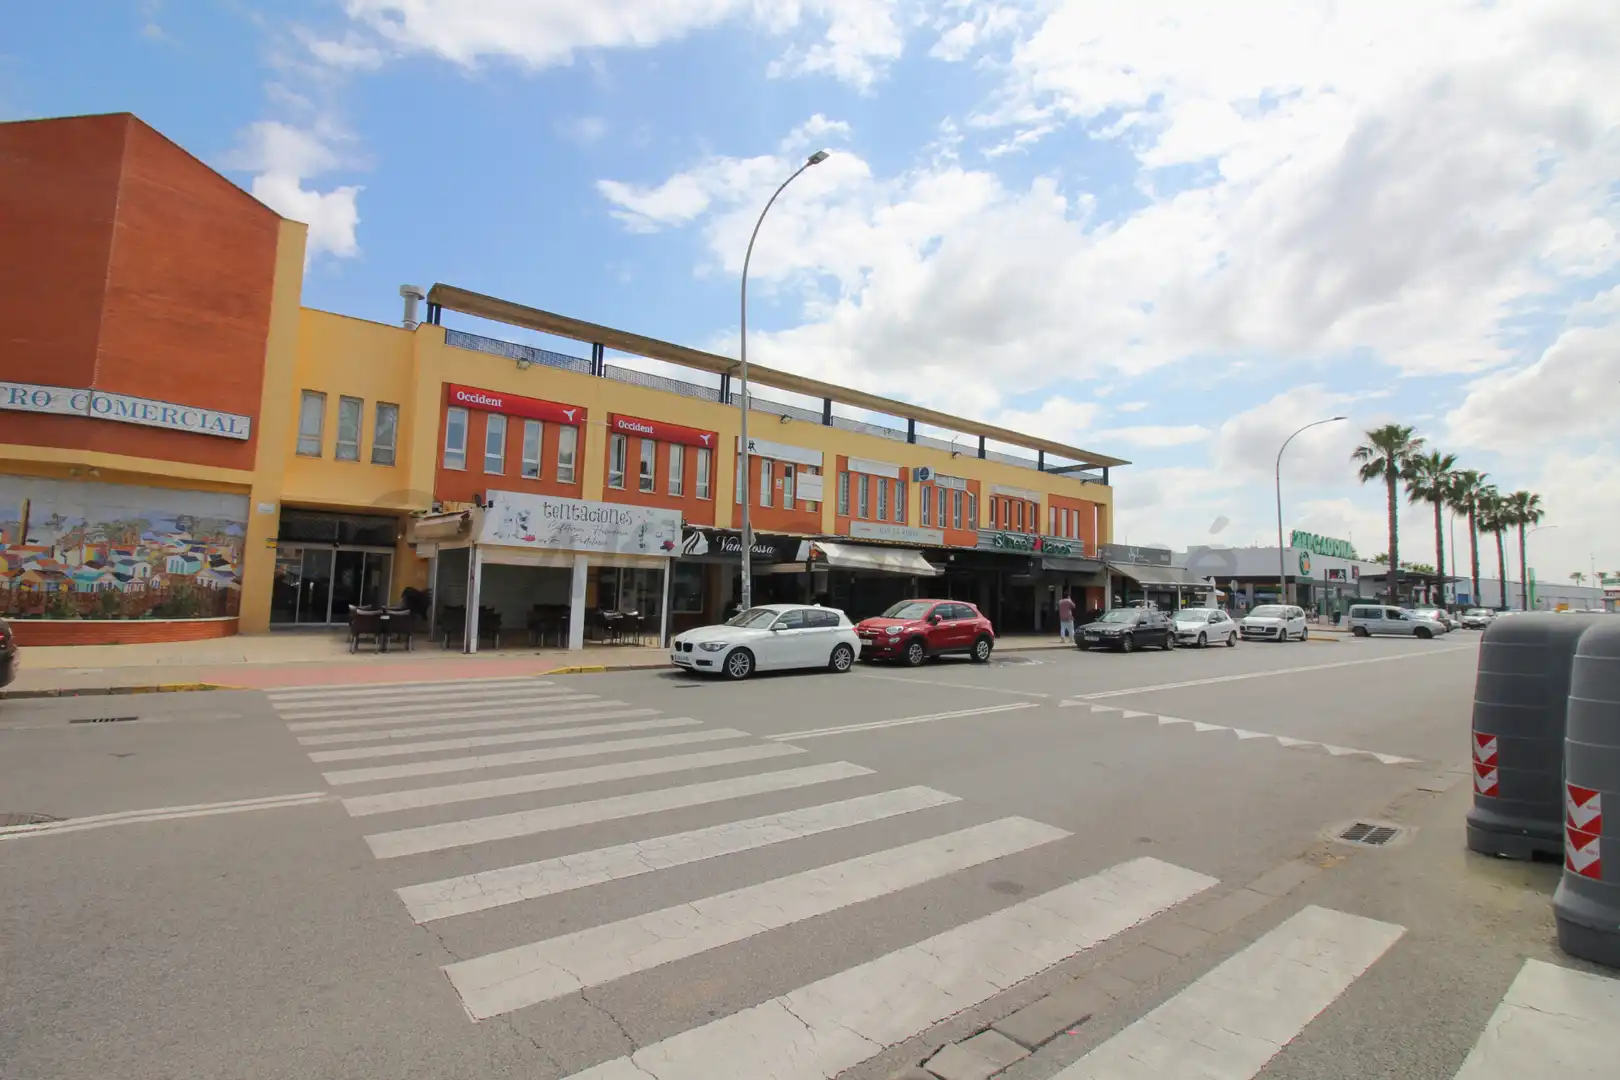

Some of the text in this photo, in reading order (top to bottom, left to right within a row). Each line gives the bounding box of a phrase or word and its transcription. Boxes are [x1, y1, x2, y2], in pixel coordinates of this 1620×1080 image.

[456, 390, 502, 408] Occident
[70, 393, 243, 435] COMERCIAL
[618, 419, 654, 434] Occident
[543, 501, 633, 525] tentaciones
